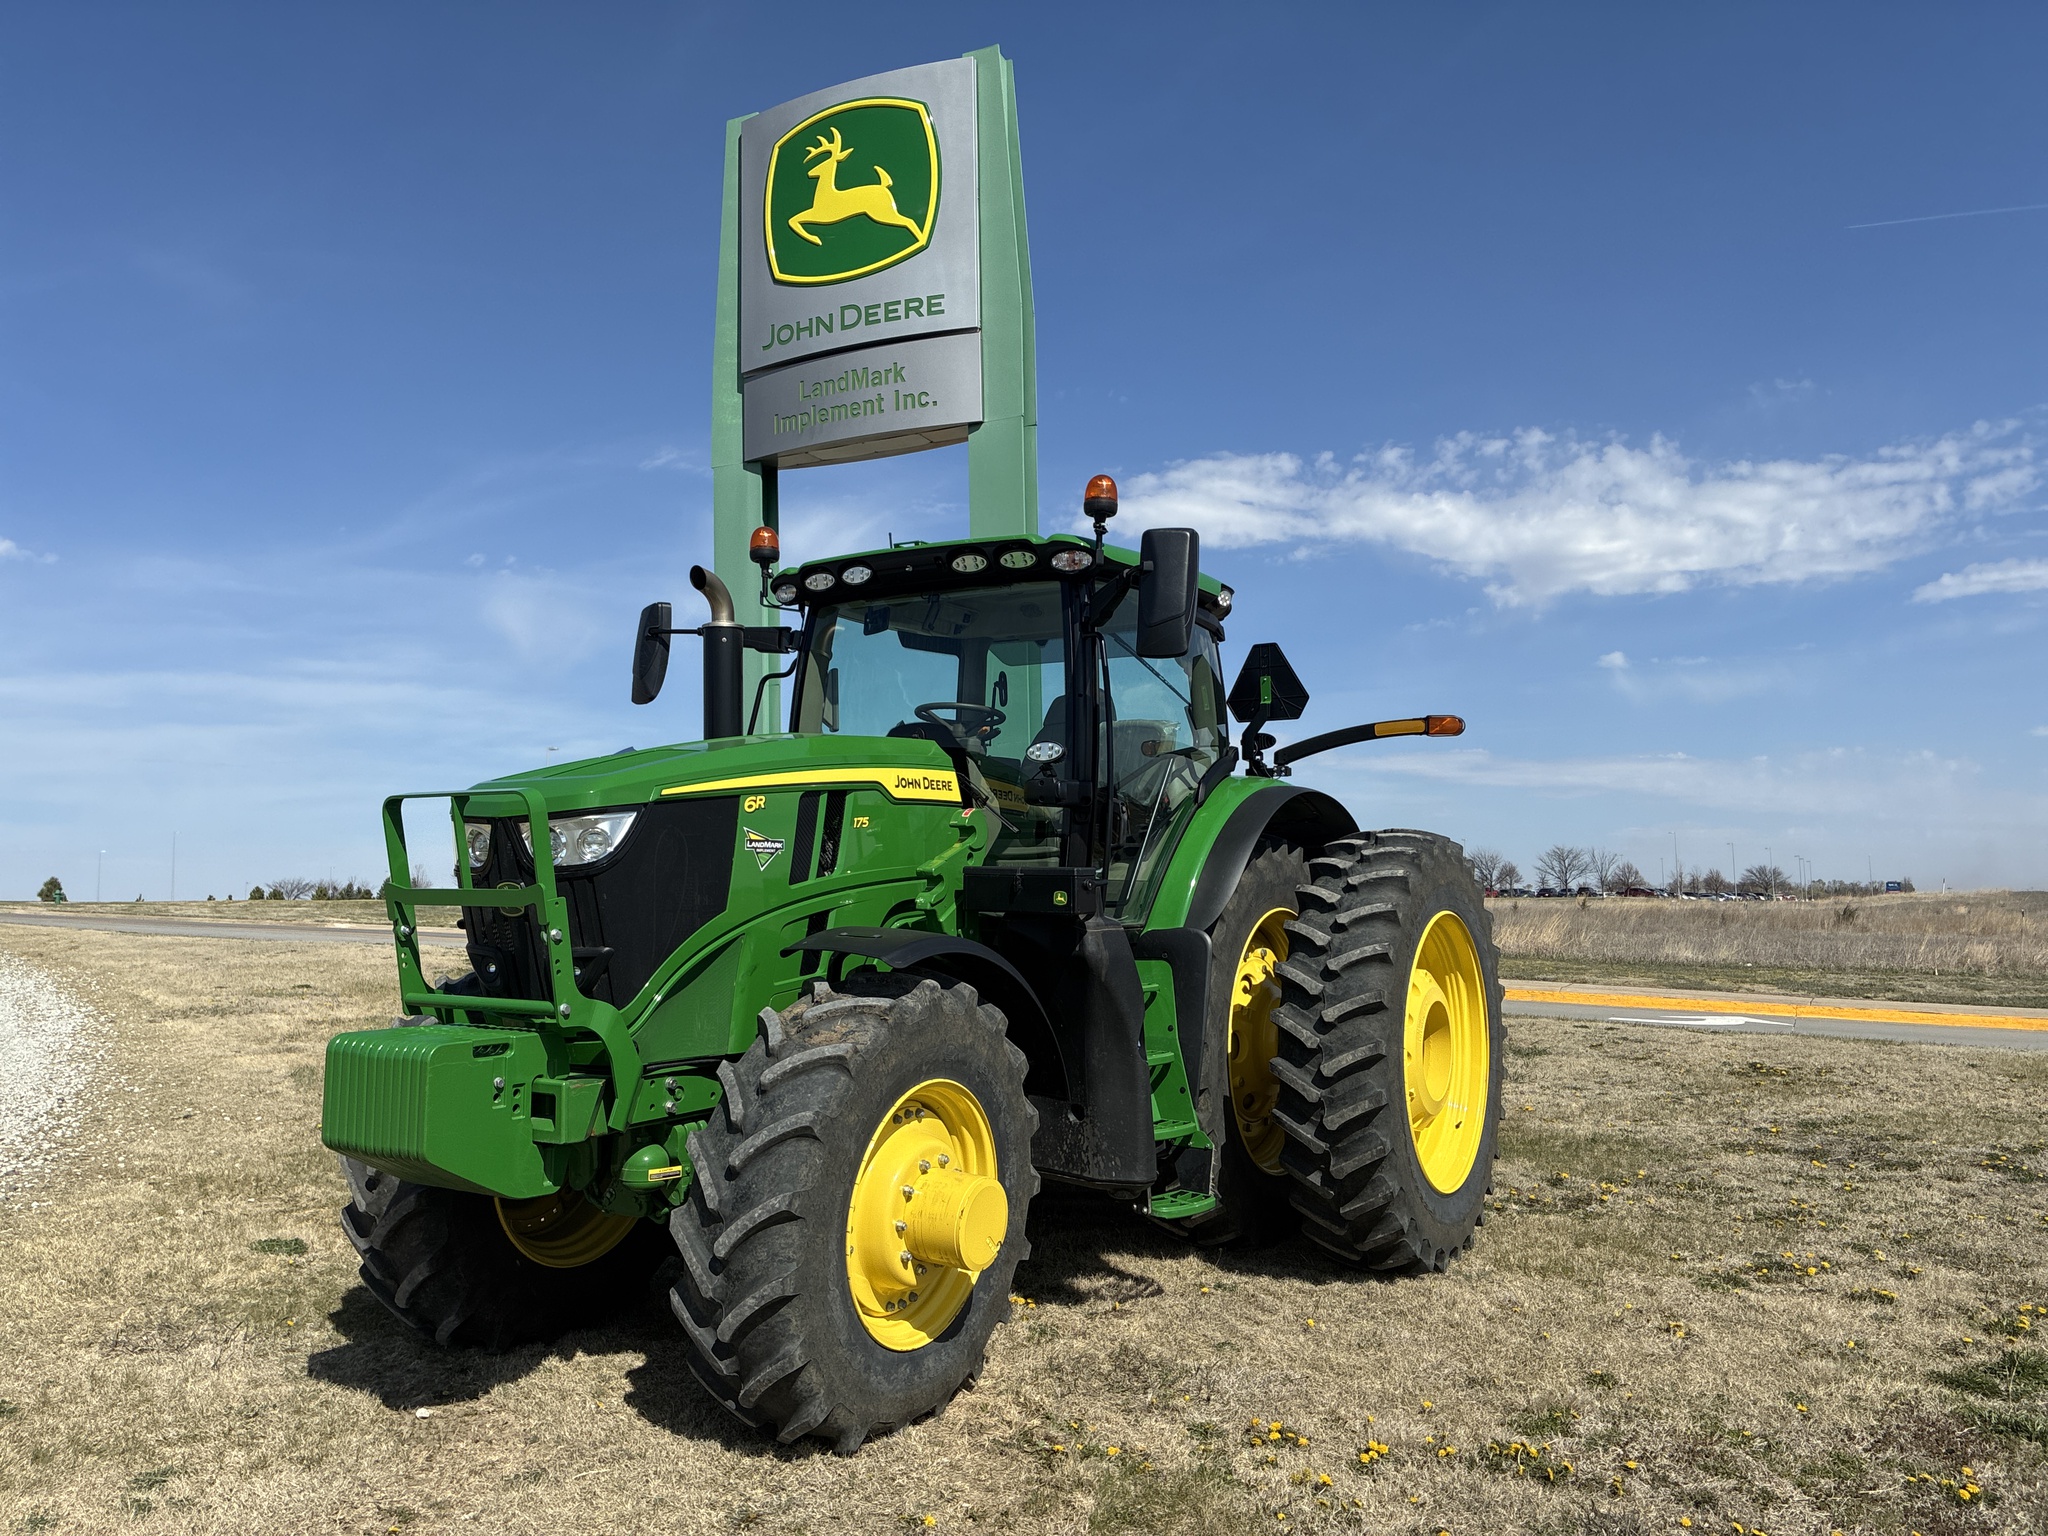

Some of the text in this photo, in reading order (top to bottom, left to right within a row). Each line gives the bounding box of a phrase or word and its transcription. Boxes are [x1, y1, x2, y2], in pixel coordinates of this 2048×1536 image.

[762, 293, 945, 351] JOHN DEERE
[799, 362, 906, 401] LandMark
[773, 389, 938, 435] Implement Inc.
[894, 775, 953, 791] JOHN DEERE
[744, 795, 766, 813] 6R
[853, 816, 870, 828] 175
